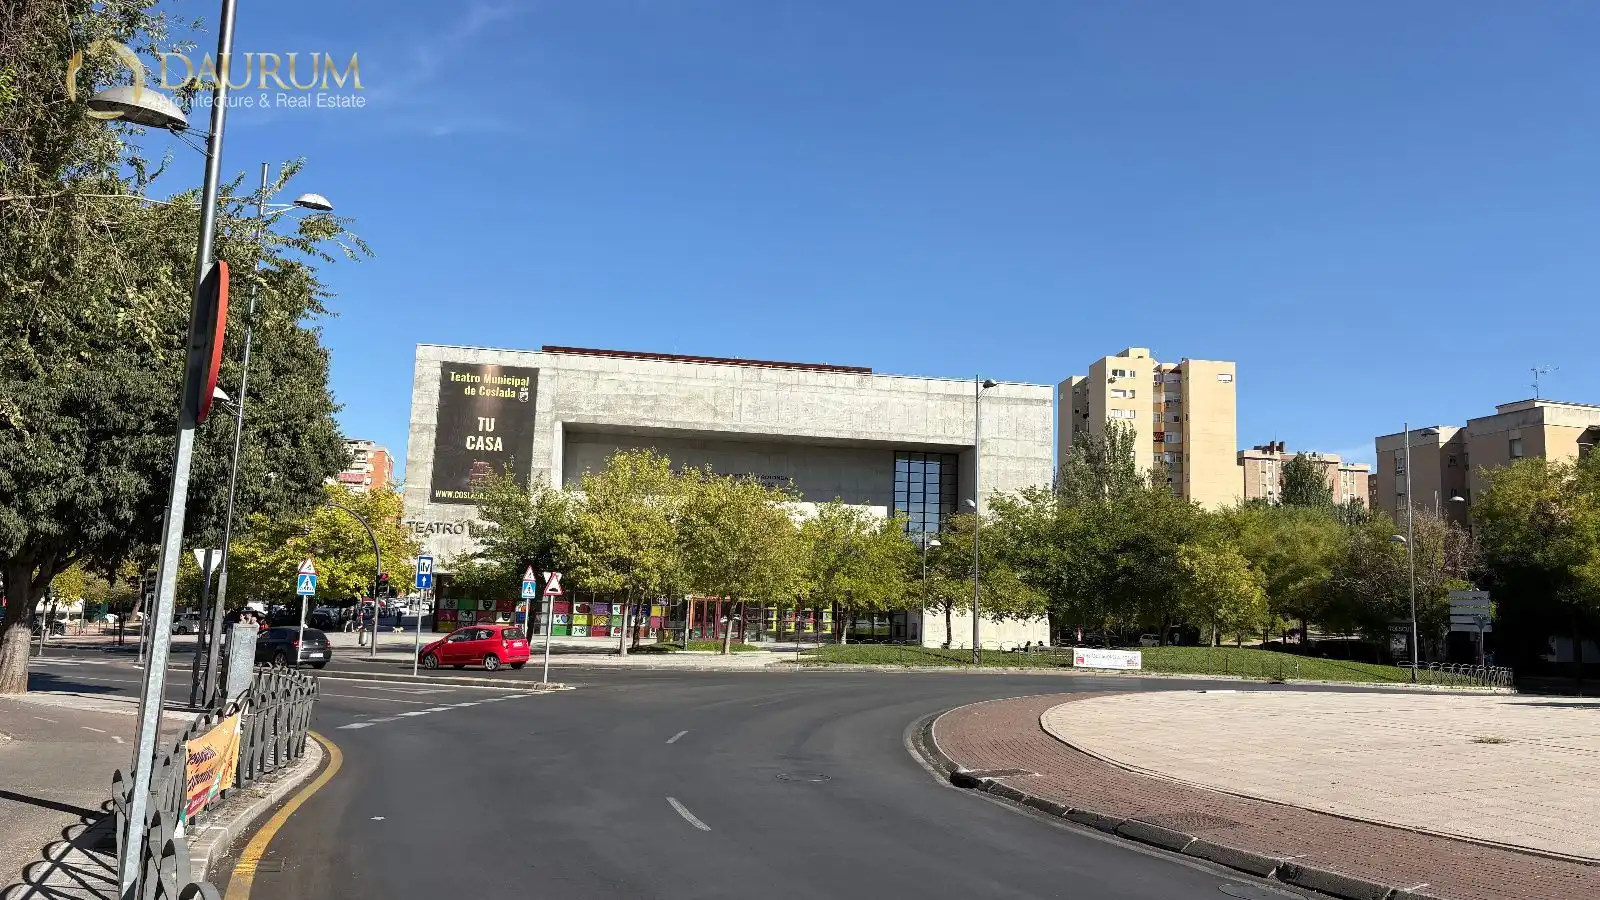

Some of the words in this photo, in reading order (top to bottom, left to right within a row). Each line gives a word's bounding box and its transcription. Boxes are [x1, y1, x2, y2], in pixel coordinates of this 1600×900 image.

[450, 371, 481, 383] Teatro
[483, 373, 530, 388] Municipal
[464, 385, 476, 396] de
[479, 385, 516, 398] Coslada
[477, 416, 496, 432] TU
[465, 435, 503, 452] CASA
[406, 520, 464, 535] TEATRO
